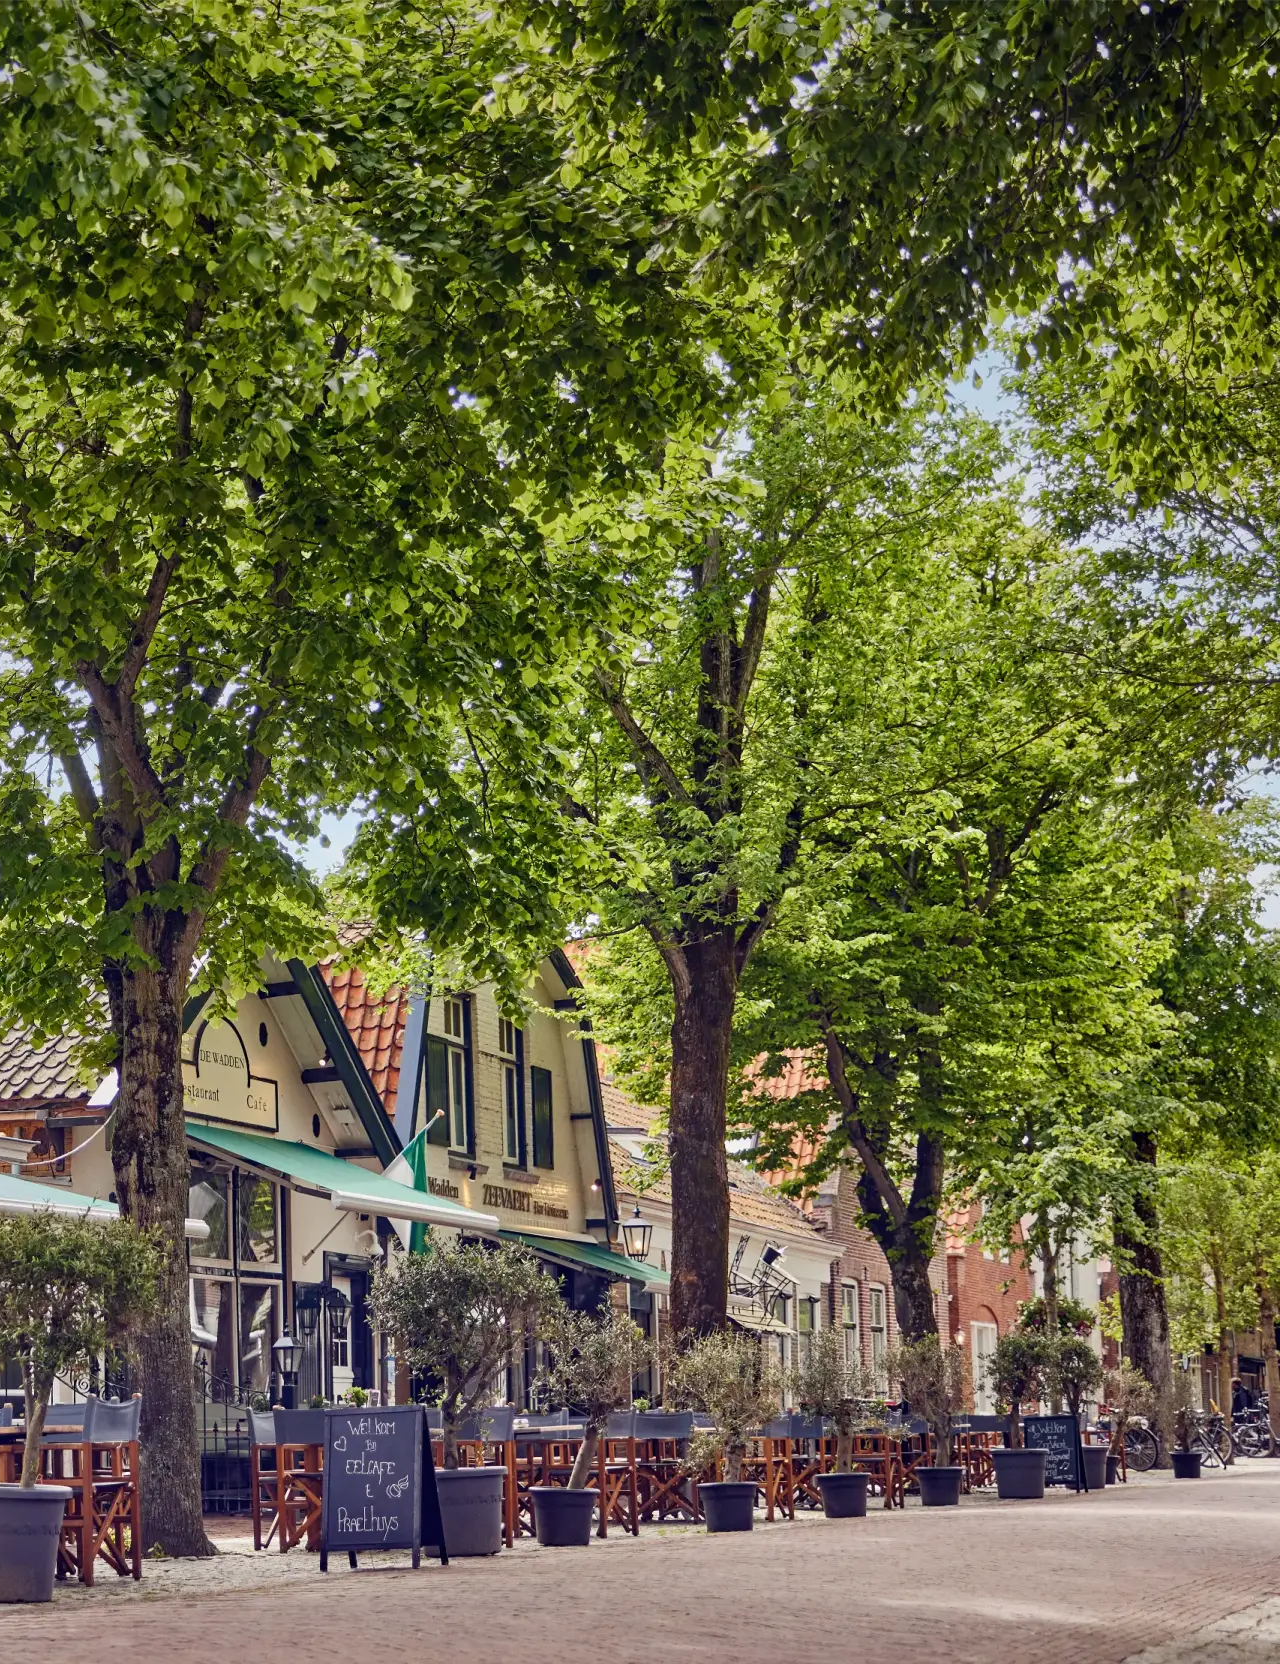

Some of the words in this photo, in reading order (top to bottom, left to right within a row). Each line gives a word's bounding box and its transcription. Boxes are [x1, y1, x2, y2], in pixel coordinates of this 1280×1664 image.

[200, 1049, 211, 1062] DE
[212, 1052, 245, 1069] WADDEN
[183, 1083, 220, 1101] estaurant
[427, 1176, 459, 1198] Wadden
[483, 1183, 532, 1213] ZEEVAERT
